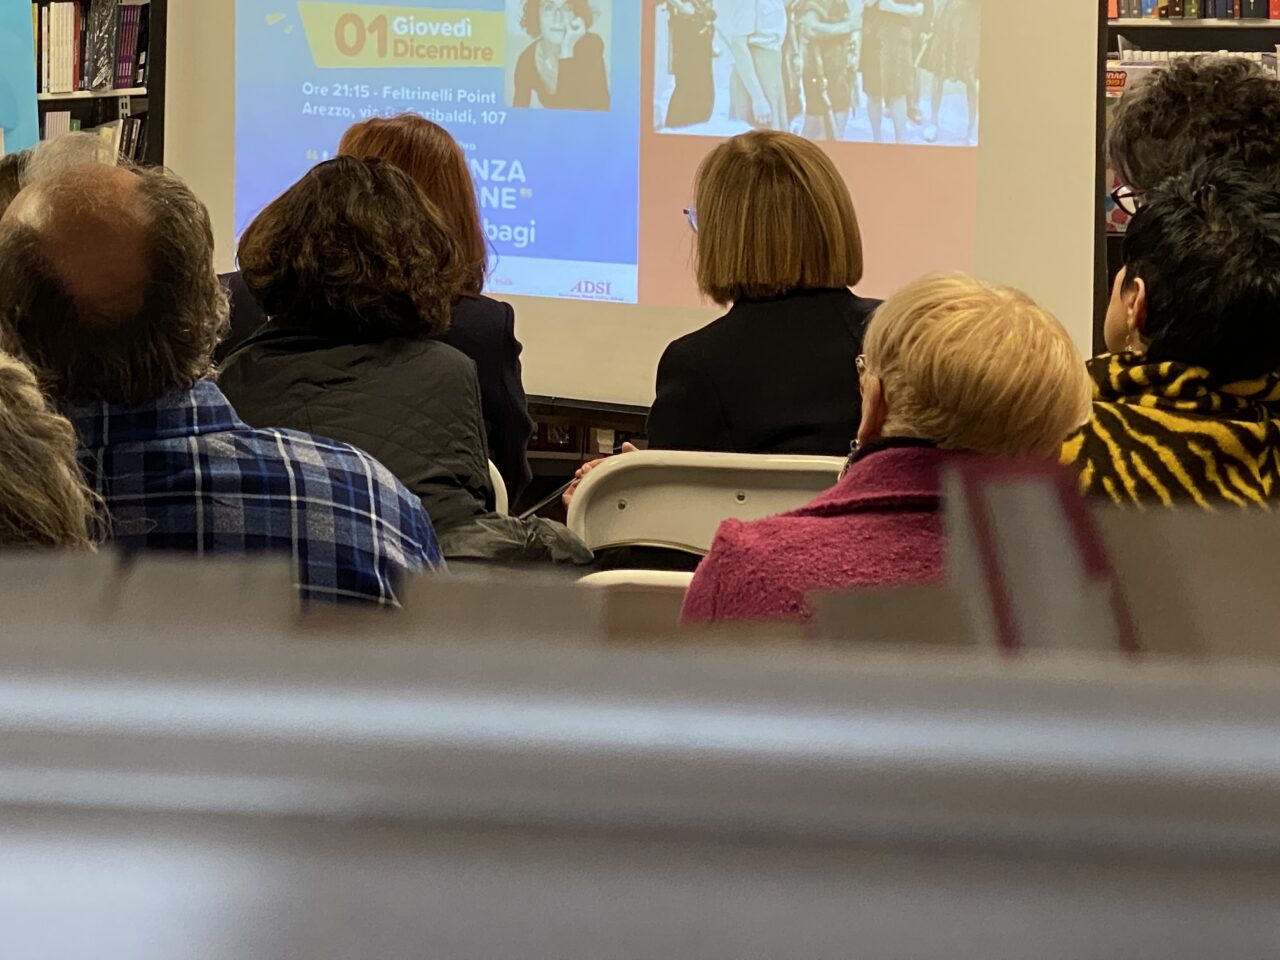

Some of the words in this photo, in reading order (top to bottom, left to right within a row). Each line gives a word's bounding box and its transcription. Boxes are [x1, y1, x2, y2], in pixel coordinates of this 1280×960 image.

[333, 12, 389, 59] 01
[392, 15, 472, 37] Giovedì
[392, 38, 494, 62] Dicembre
[302, 81, 329, 97] Ore
[332, 83, 370, 98] 21:15
[382, 86, 453, 103] Feltrinelli
[457, 89, 497, 104] Point
[302, 101, 356, 119] Arezzo,
[481, 111, 507, 125] 107
[483, 217, 536, 248] bagi
